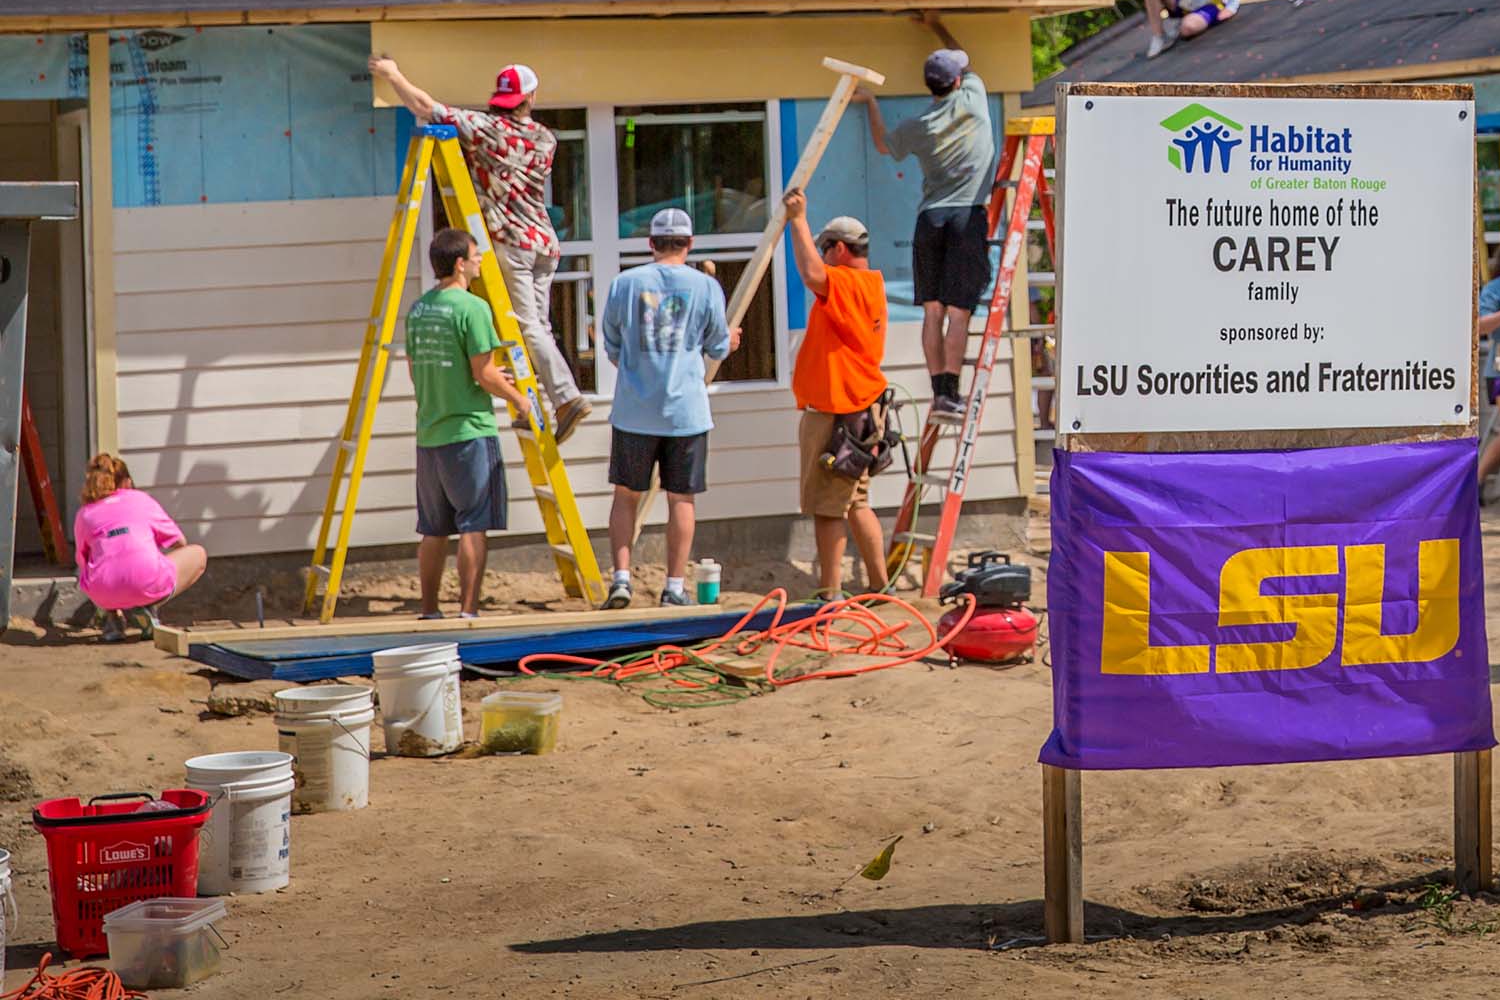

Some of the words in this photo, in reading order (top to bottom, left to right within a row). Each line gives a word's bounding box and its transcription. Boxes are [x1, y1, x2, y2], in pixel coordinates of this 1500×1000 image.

[1249, 125, 1352, 154] Habitat
[1250, 155, 1273, 172] for
[1278, 155, 1352, 175] Humanity
[1250, 176, 1263, 190] of
[1265, 177, 1310, 190] Greater
[1313, 177, 1347, 190] Baton
[1350, 178, 1387, 192] Rouge
[1166, 198, 1199, 227] The
[1206, 198, 1263, 227] future
[1269, 199, 1319, 227] home
[1325, 198, 1345, 227] of
[1350, 198, 1379, 226] the
[1212, 236, 1340, 272] CAREY
[1248, 281, 1299, 304] family
[1219, 323, 1298, 344] sponsored
[1303, 322, 1324, 343] by:
[1077, 364, 1128, 397] LSU
[1136, 363, 1258, 396] Sororities
[1266, 362, 1309, 394] and
[1318, 360, 1456, 393] Fraternities
[1100, 538, 1461, 675] LSU
[104, 847, 145, 861] LOWE'S
